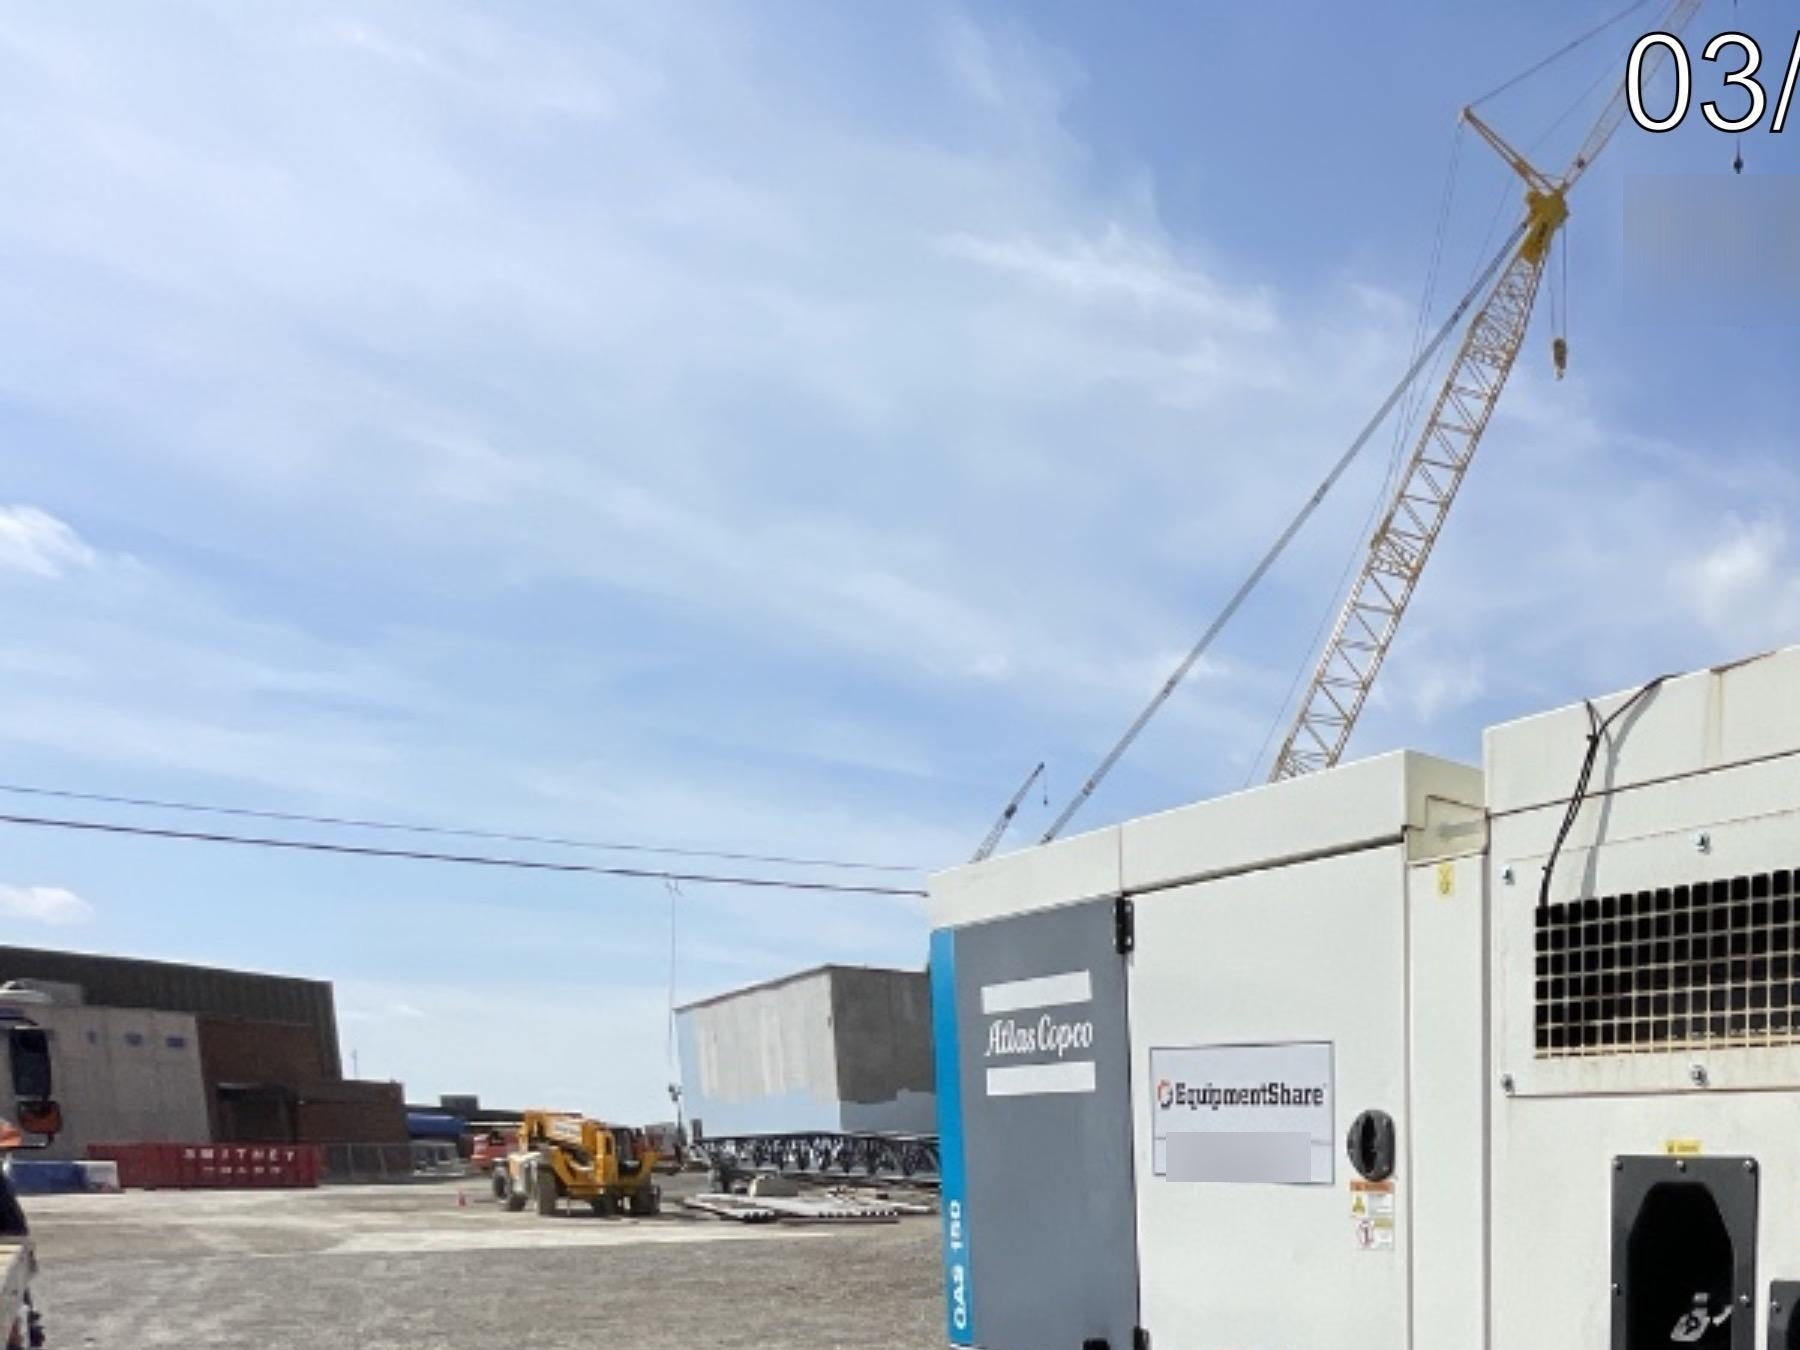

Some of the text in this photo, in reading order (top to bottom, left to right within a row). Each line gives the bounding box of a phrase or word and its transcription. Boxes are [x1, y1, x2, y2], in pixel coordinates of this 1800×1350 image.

[984, 1014, 1094, 1057] Atlas Copco
[1175, 1081, 1325, 1110] EquipmentShare
